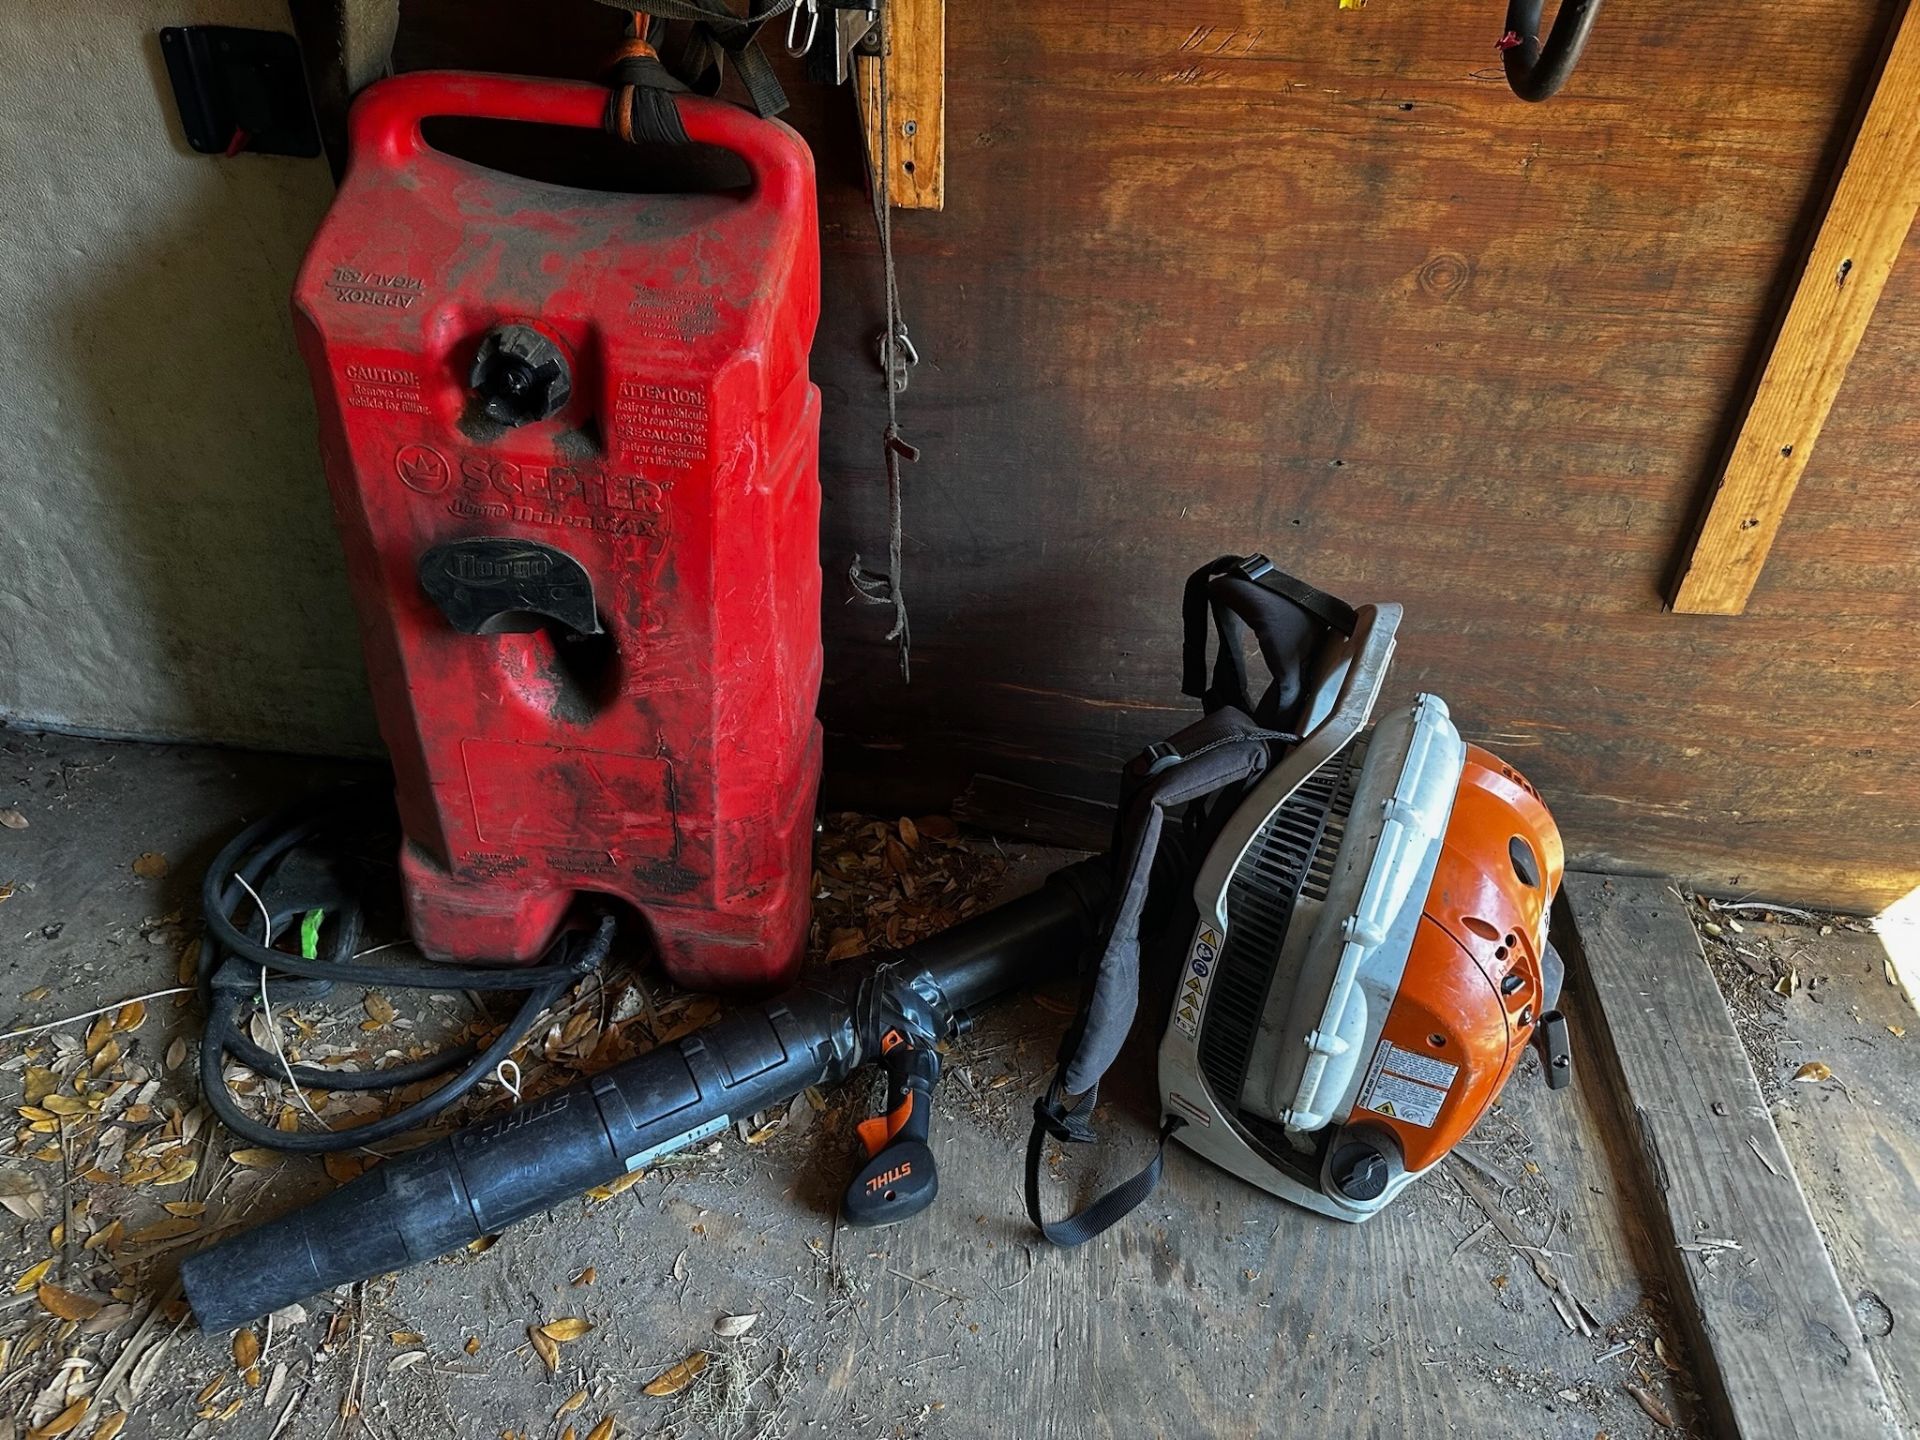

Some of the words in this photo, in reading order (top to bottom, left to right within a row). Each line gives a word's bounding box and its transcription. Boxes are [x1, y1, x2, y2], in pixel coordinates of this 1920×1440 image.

[333, 288, 414, 309] APPROX.
[346, 365, 420, 385] CAUTION:
[354, 384, 394, 398] Remove
[396, 388, 420, 401] from
[348, 396, 383, 409] vehicle
[385, 399, 400, 411] for
[482, 1092, 571, 1138] STIHL
[865, 1161, 912, 1191] STIHL
